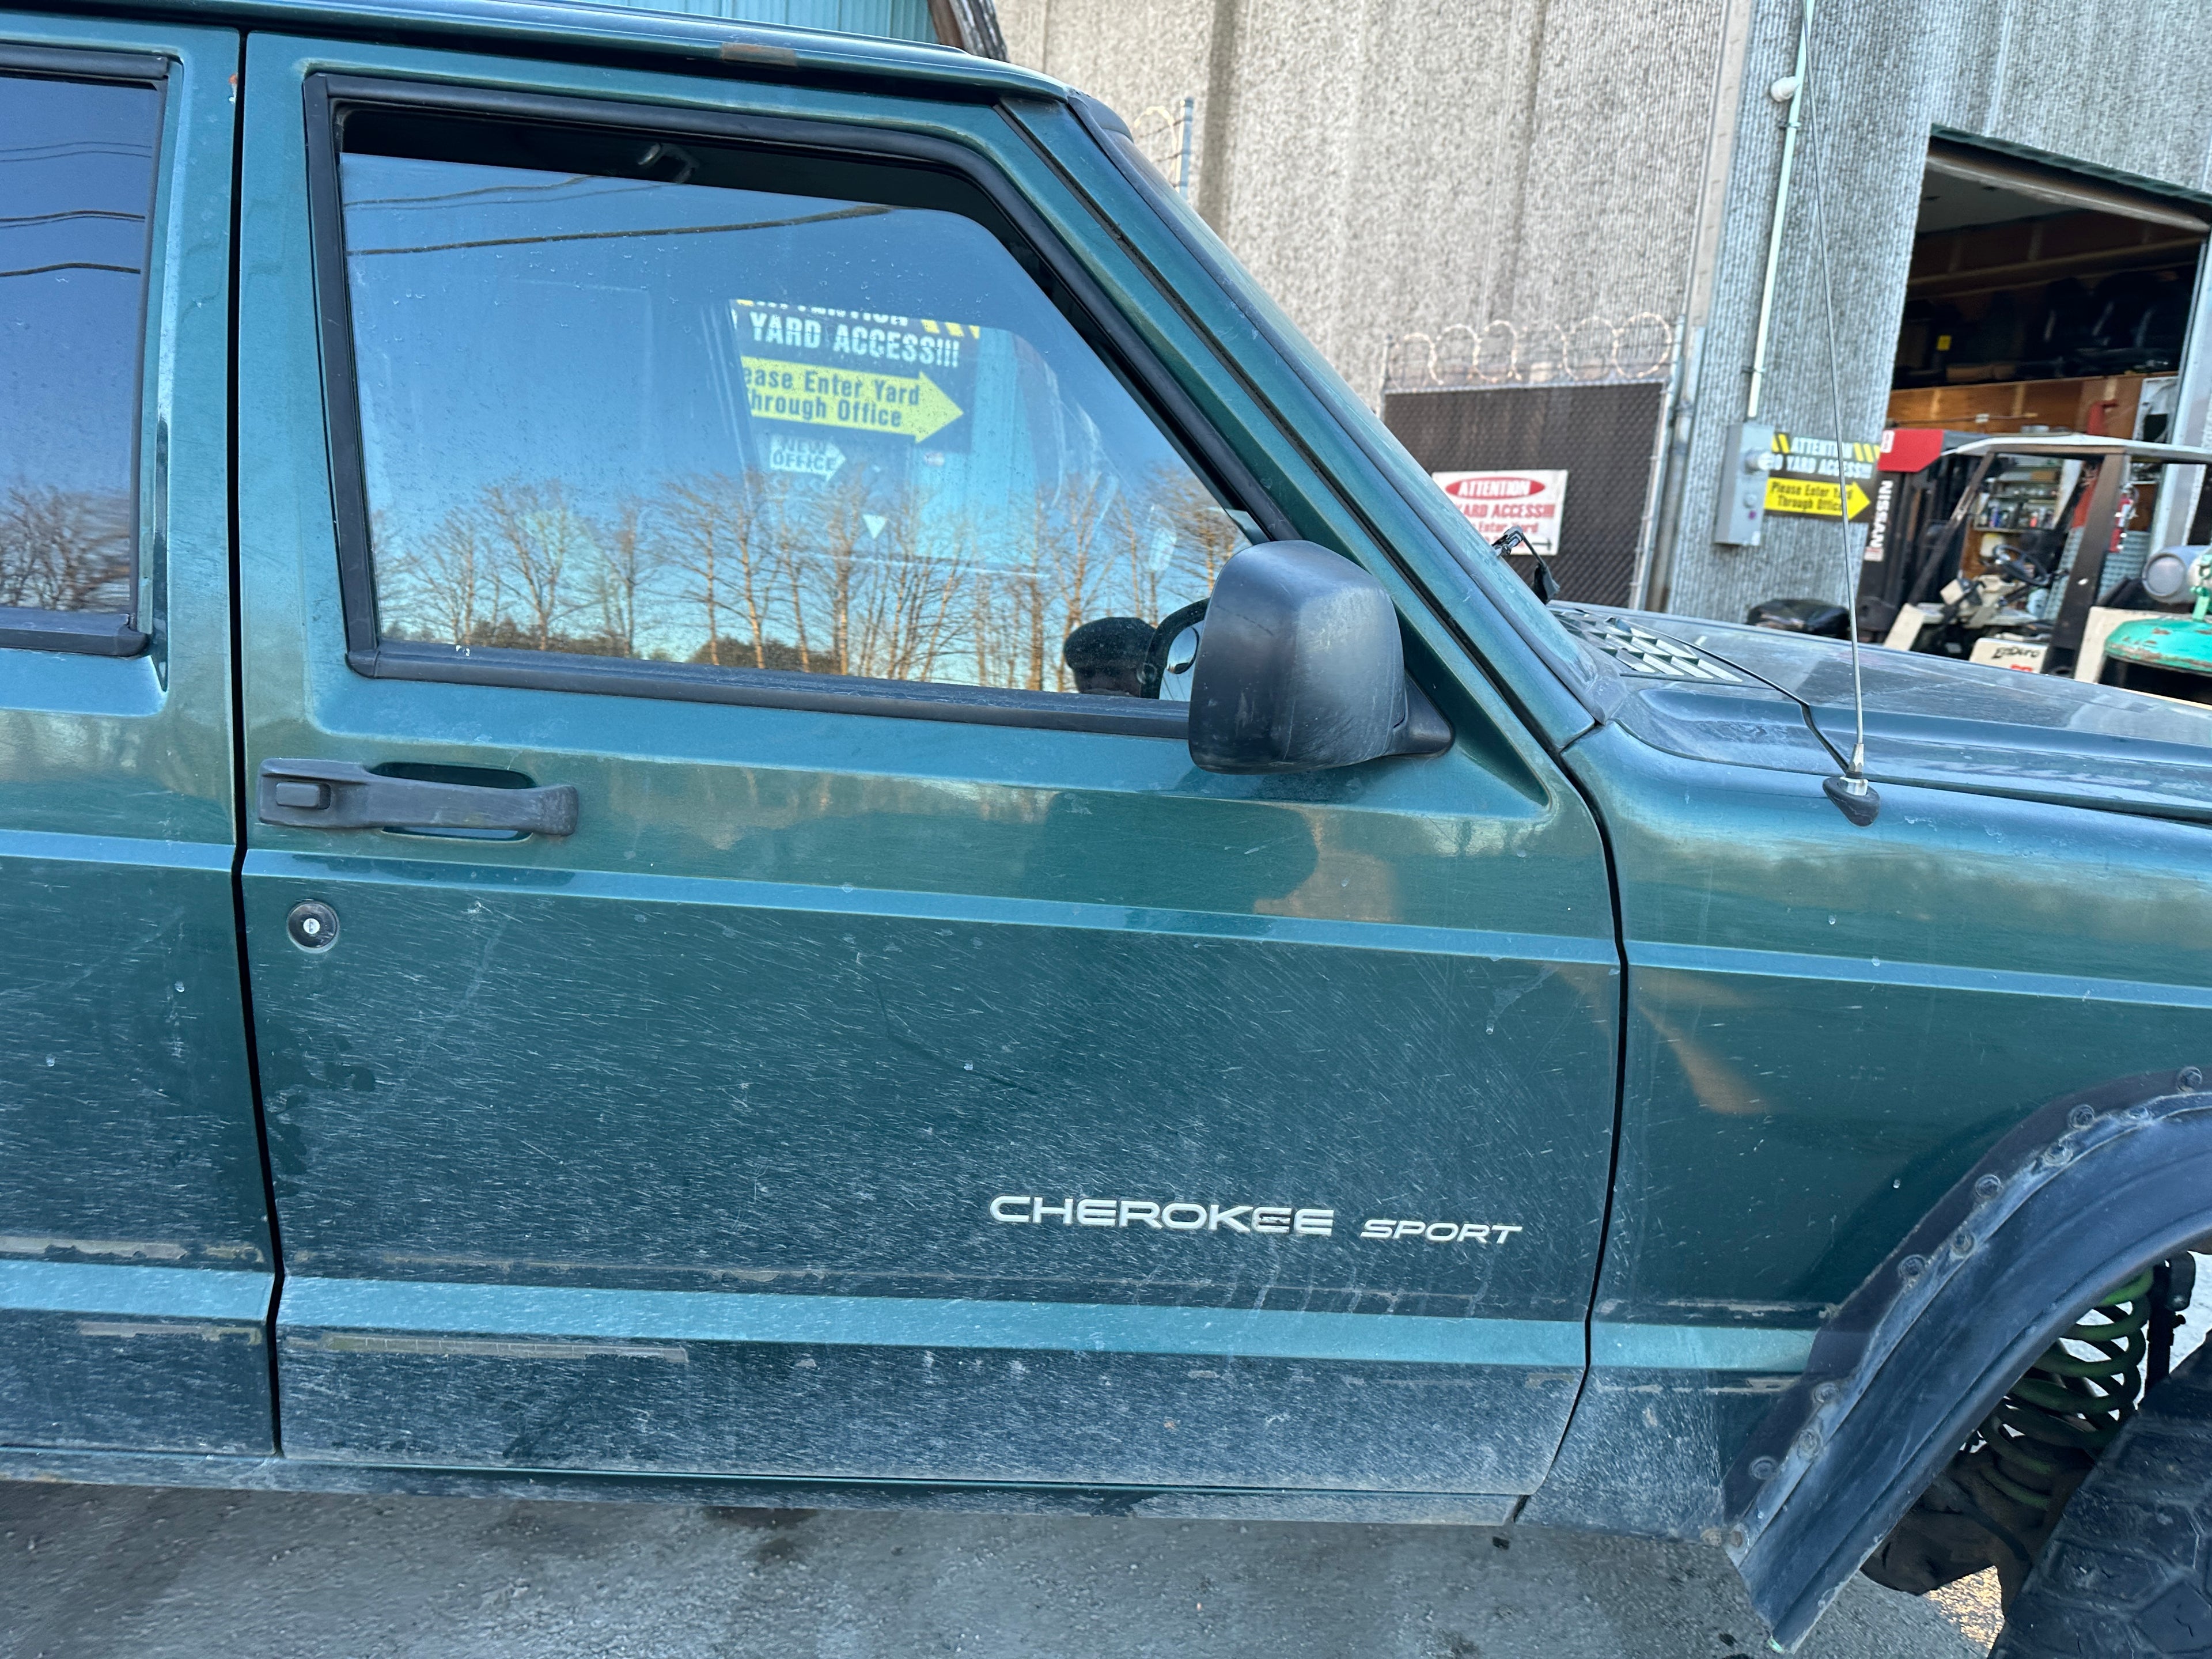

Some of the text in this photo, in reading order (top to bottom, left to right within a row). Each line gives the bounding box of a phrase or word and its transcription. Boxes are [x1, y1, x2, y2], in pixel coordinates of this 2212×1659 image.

[749, 311, 821, 349] YARD
[833, 324, 960, 368] ACCESS!!!
[744, 367, 920, 406] ease Enter Yard
[751, 389, 902, 427] hrough Office
[772, 449, 836, 471] OFFICE
[1457, 479, 1531, 497] ATTENTION
[1771, 482, 1801, 495] Please
[1805, 484, 1829, 497] Enter
[1870, 480, 1893, 548] NISSAN
[989, 1195, 1522, 1244] CHEROKEE SPORT
